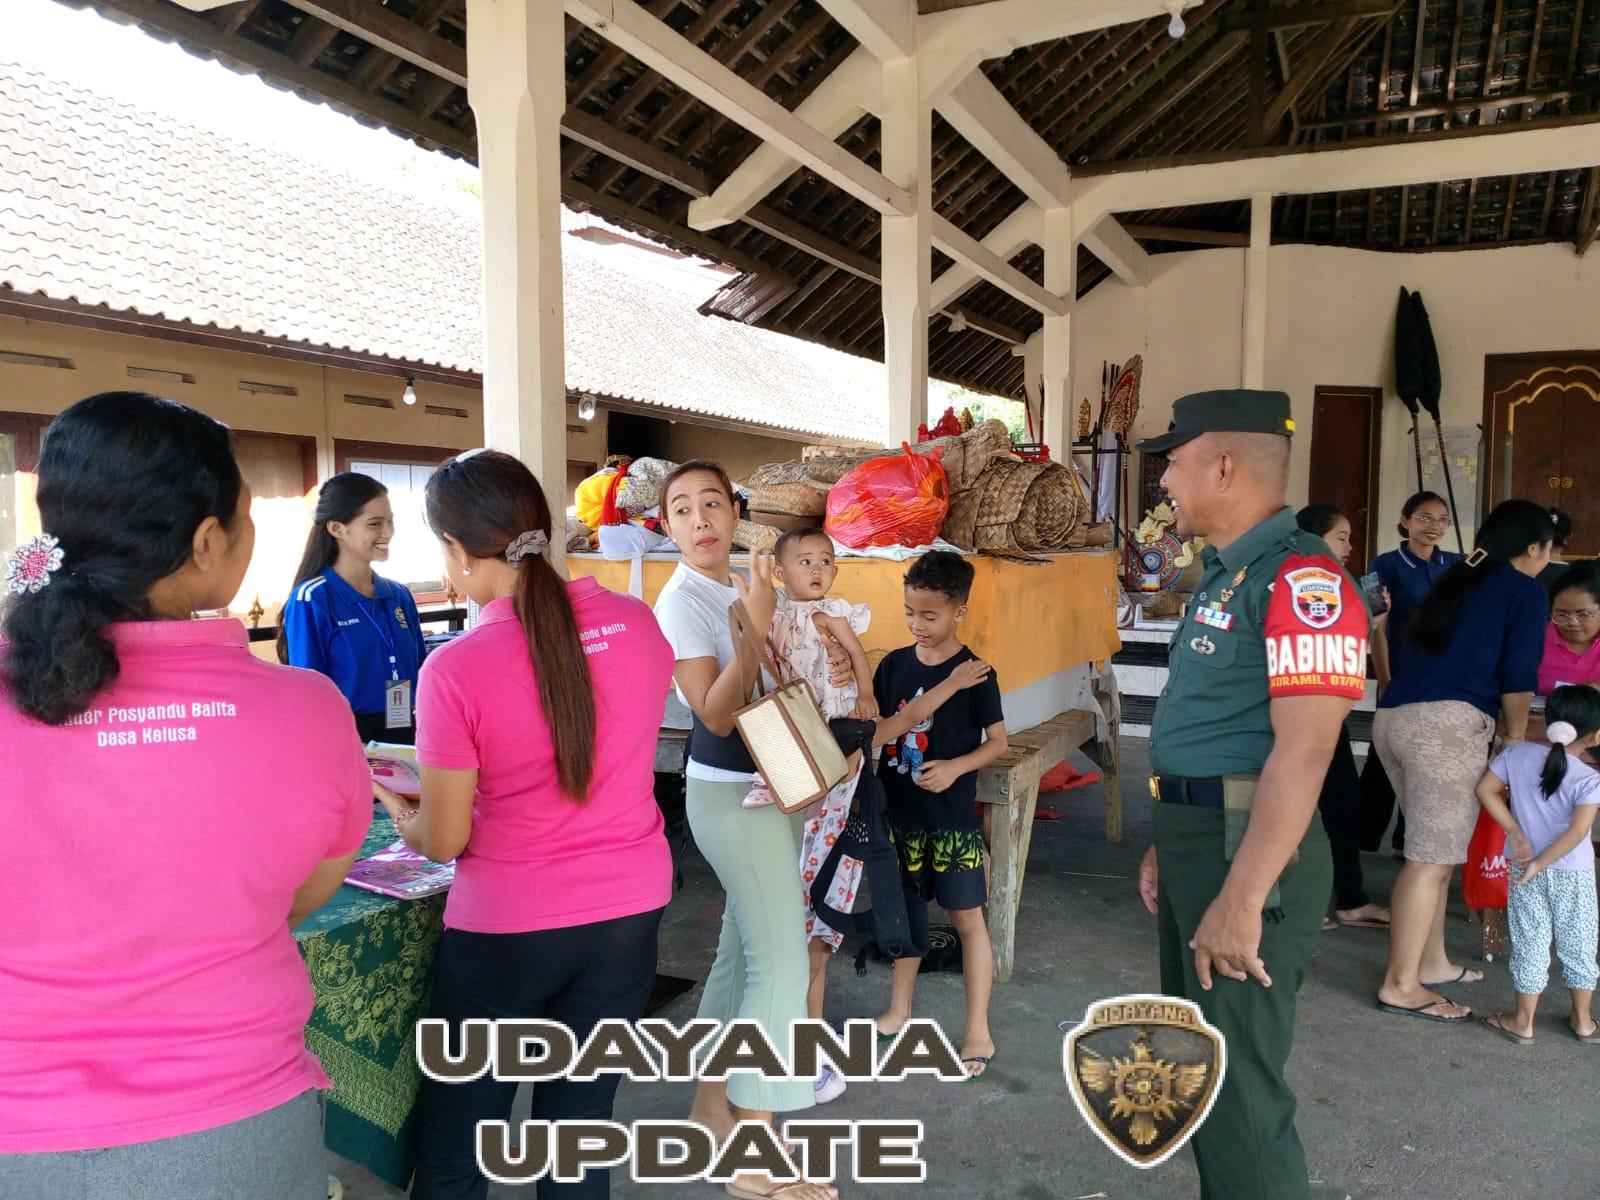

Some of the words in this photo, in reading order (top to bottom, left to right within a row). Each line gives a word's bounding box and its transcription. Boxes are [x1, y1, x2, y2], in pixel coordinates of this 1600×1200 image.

[601, 623, 626, 635] Balita
[108, 703, 187, 723] Posyandu
[192, 701, 237, 718] Balita
[97, 730, 137, 748] Desa
[141, 726, 197, 744] Kelusa
